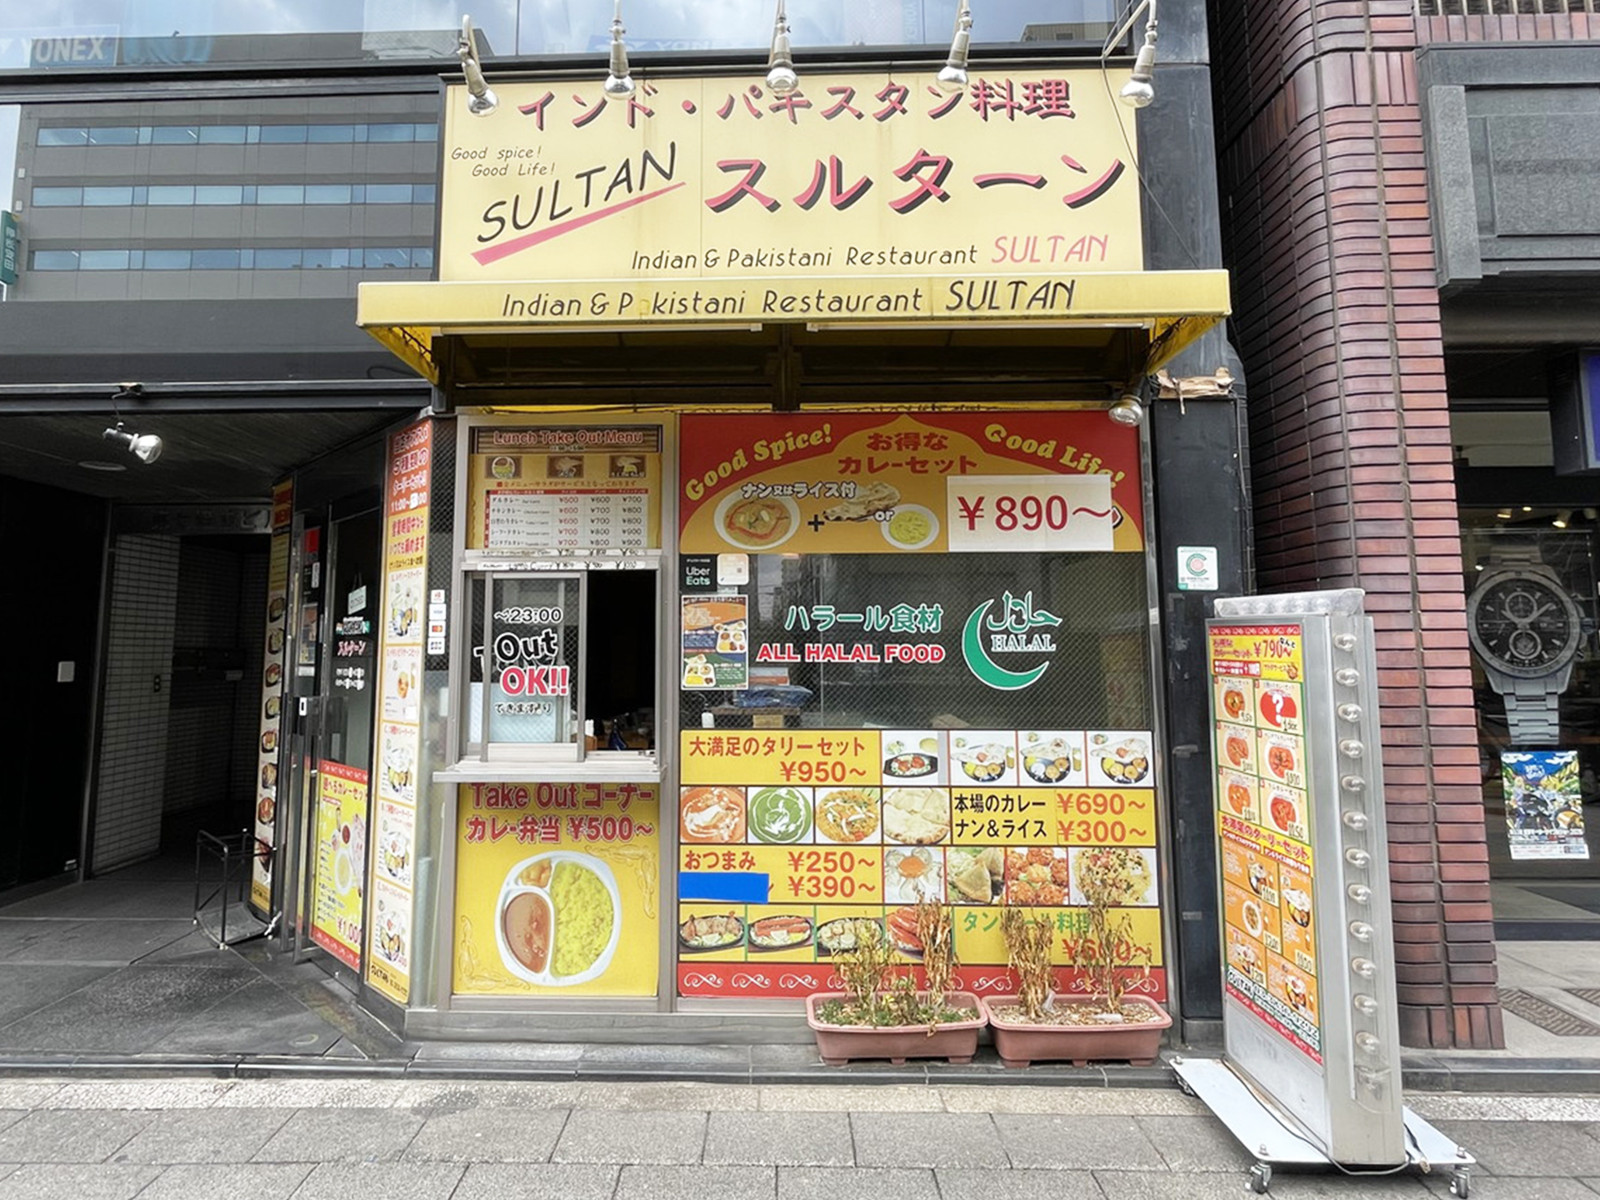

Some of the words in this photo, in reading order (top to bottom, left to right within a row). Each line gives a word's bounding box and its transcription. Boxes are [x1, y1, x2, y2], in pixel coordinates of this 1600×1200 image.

[21, 36, 106, 63] YONEX
[518, 78, 1076, 131] インド・パキスタン料理
[451, 147, 489, 161] Good
[497, 146, 542, 160] spice!
[472, 163, 510, 177] Good
[518, 163, 556, 177] Life!
[704, 147, 1126, 215] スルターン
[477, 141, 677, 244] SULTAN
[631, 249, 698, 271] Indian
[703, 247, 721, 269] &
[728, 246, 833, 268] Pakistani
[846, 244, 978, 267] Restaurant
[991, 233, 1109, 264] SULTAN
[502, 292, 582, 317] Indian
[590, 292, 610, 316] &
[618, 289, 746, 316] Pkistani
[762, 286, 923, 313] Restaurant
[945, 278, 1076, 311] SULTAN
[494, 431, 537, 445] Lunch
[541, 431, 574, 445] Take
[576, 430, 604, 445] Out
[605, 430, 644, 444] Menu
[866, 432, 949, 451] お得な
[984, 423, 1058, 460] Good
[685, 449, 749, 501] Good
[753, 423, 832, 461] Spice!
[837, 455, 978, 475] カレーセット
[742, 482, 857, 499] ナン又はライス付
[874, 509, 895, 522] or
[686, 566, 710, 576] Uber
[686, 576, 711, 585] Eats
[785, 603, 944, 633] ハラール食材
[496, 630, 559, 662] Out
[756, 643, 799, 662] ALL
[805, 643, 880, 663] HALAL
[884, 643, 946, 664] FOOD
[991, 633, 1057, 652] HALAL
[501, 666, 569, 696] OK!!
[689, 736, 865, 757] 大満足のタリーセット
[780, 761, 866, 782] ¥950～
[471, 782, 529, 809] Take
[535, 782, 579, 809] Out
[584, 782, 655, 811] コーナー
[954, 793, 1047, 813] 本場のカレー
[1057, 792, 1147, 815] ¥690～
[467, 815, 562, 844] カレー弁当
[568, 814, 654, 842] ¥500～
[955, 819, 1048, 839] ナン&ライス
[1058, 820, 1148, 843] ¥300～
[684, 850, 757, 870] おつまみ
[788, 851, 876, 873] ¥250～
[788, 875, 876, 898] ¥390～
[1062, 938, 1152, 962] ¥60～
